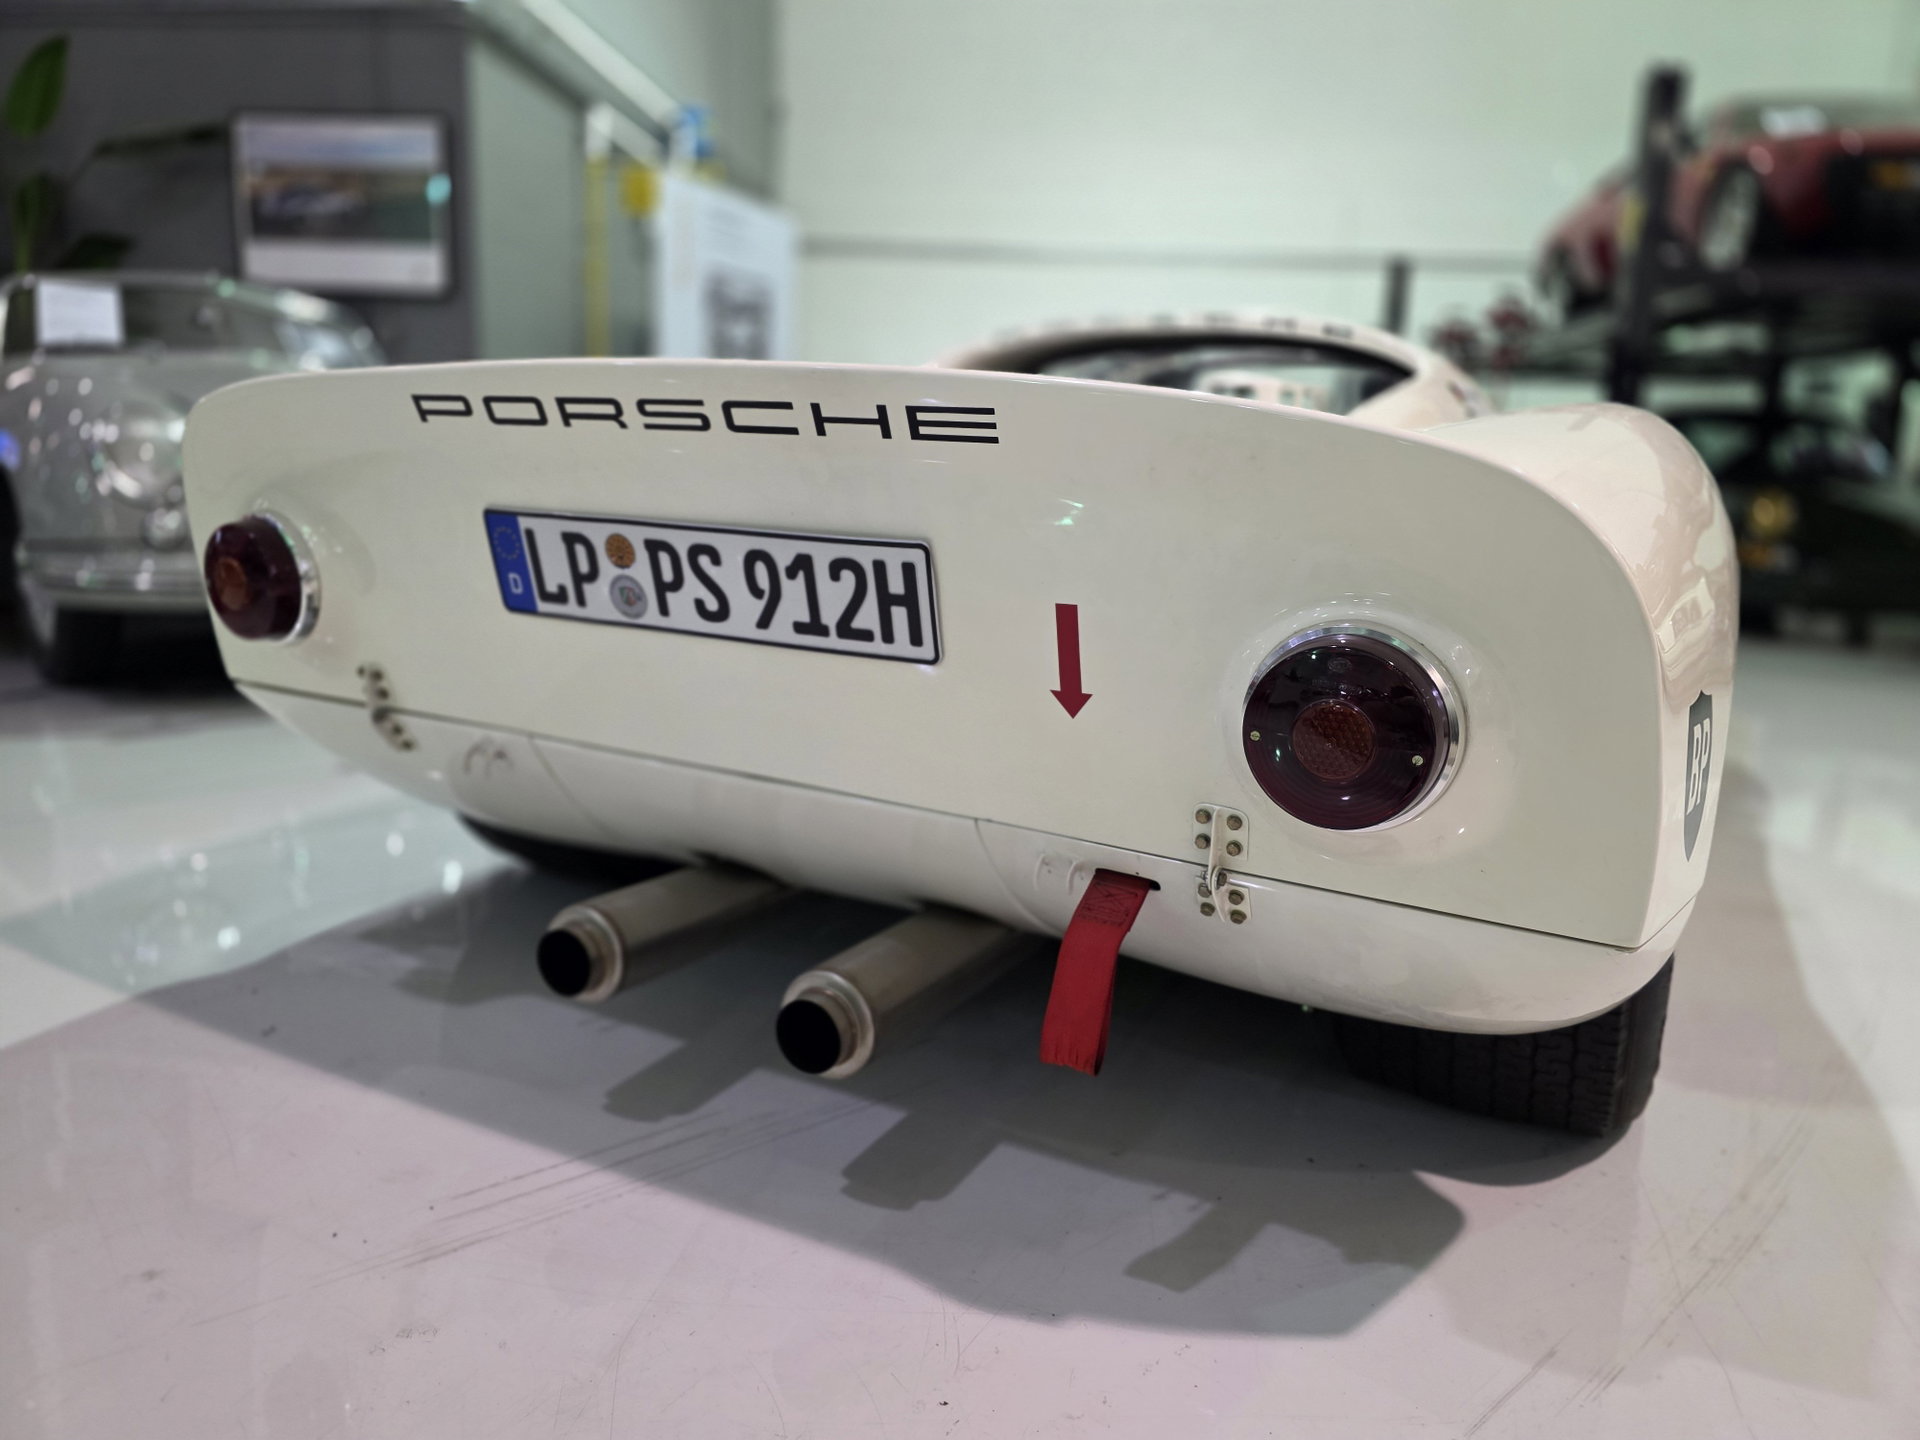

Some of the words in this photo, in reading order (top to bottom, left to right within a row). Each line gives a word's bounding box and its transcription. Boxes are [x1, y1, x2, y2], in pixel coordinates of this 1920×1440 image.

[411, 394, 1000, 444] PORSCHE
[508, 571, 524, 595] D
[524, 527, 600, 609] LP
[644, 538, 731, 624] PS
[743, 547, 924, 648] 912H
[1686, 717, 1711, 816] BP
